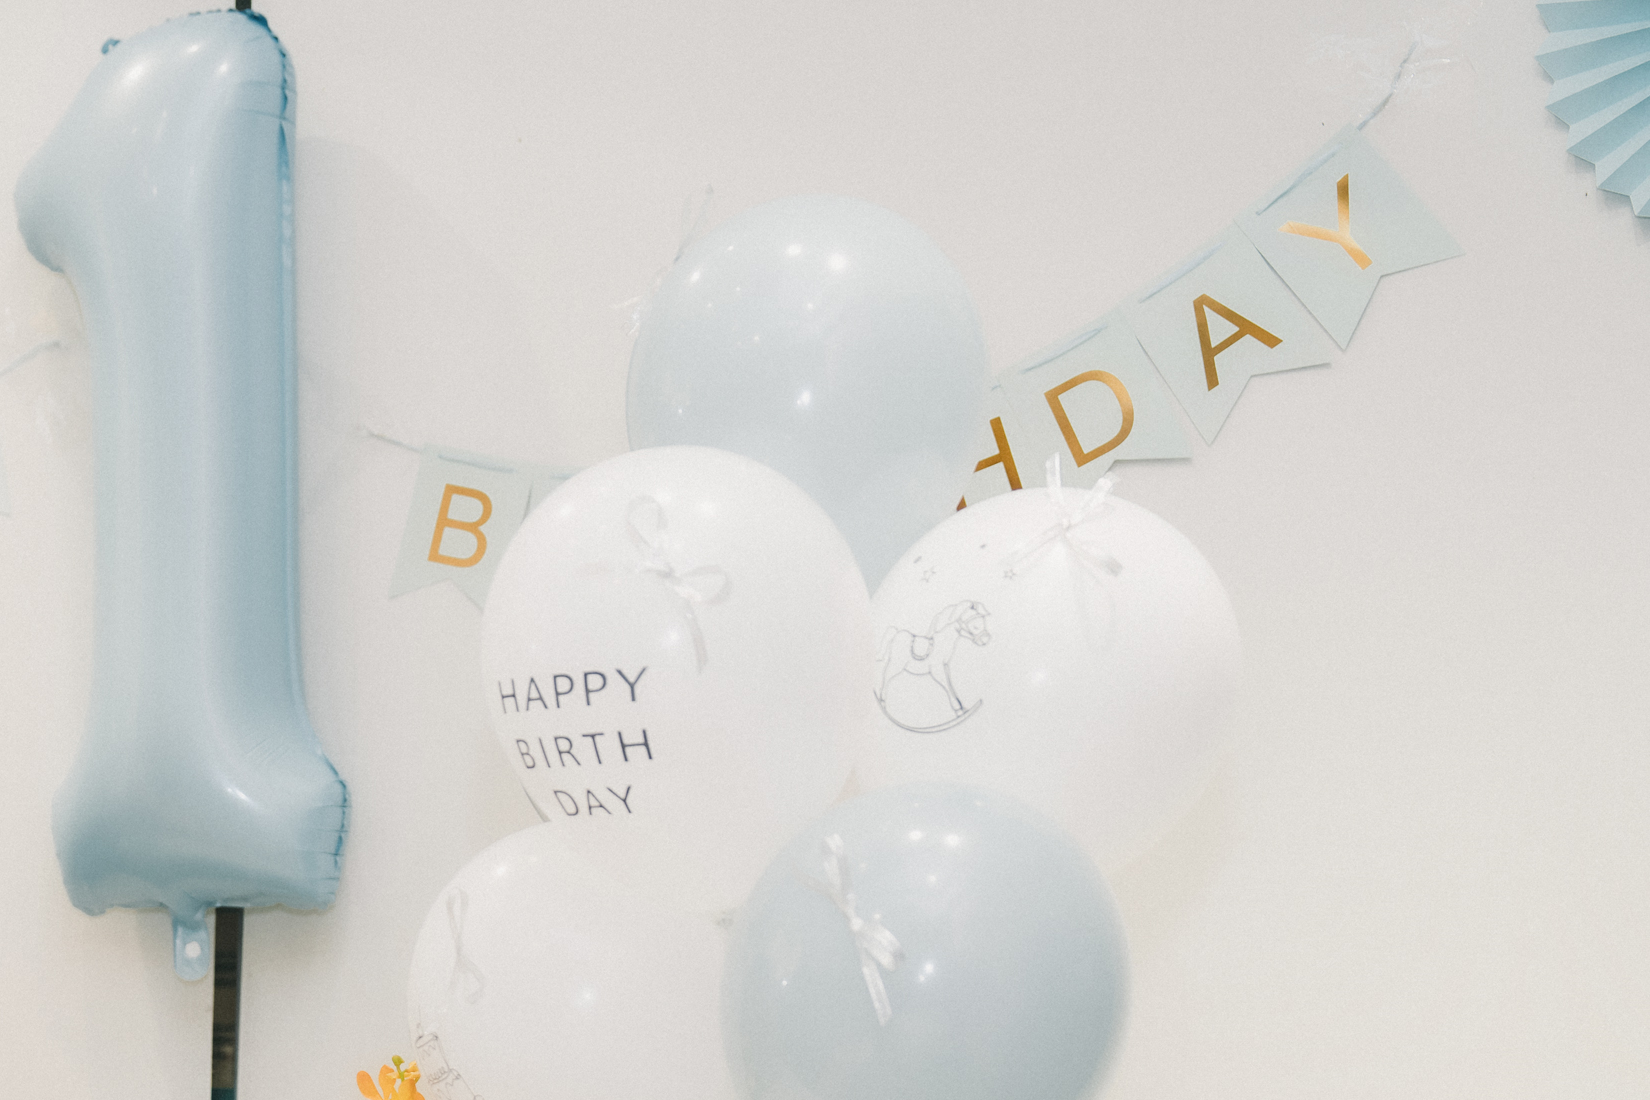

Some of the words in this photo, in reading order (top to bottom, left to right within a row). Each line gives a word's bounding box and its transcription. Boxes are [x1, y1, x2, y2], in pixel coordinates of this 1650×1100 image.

[15, 8, 352, 918] 1
[498, 666, 648, 714] HAPPY
[516, 729, 653, 769] BIRTH
[553, 785, 633, 817] DAY
